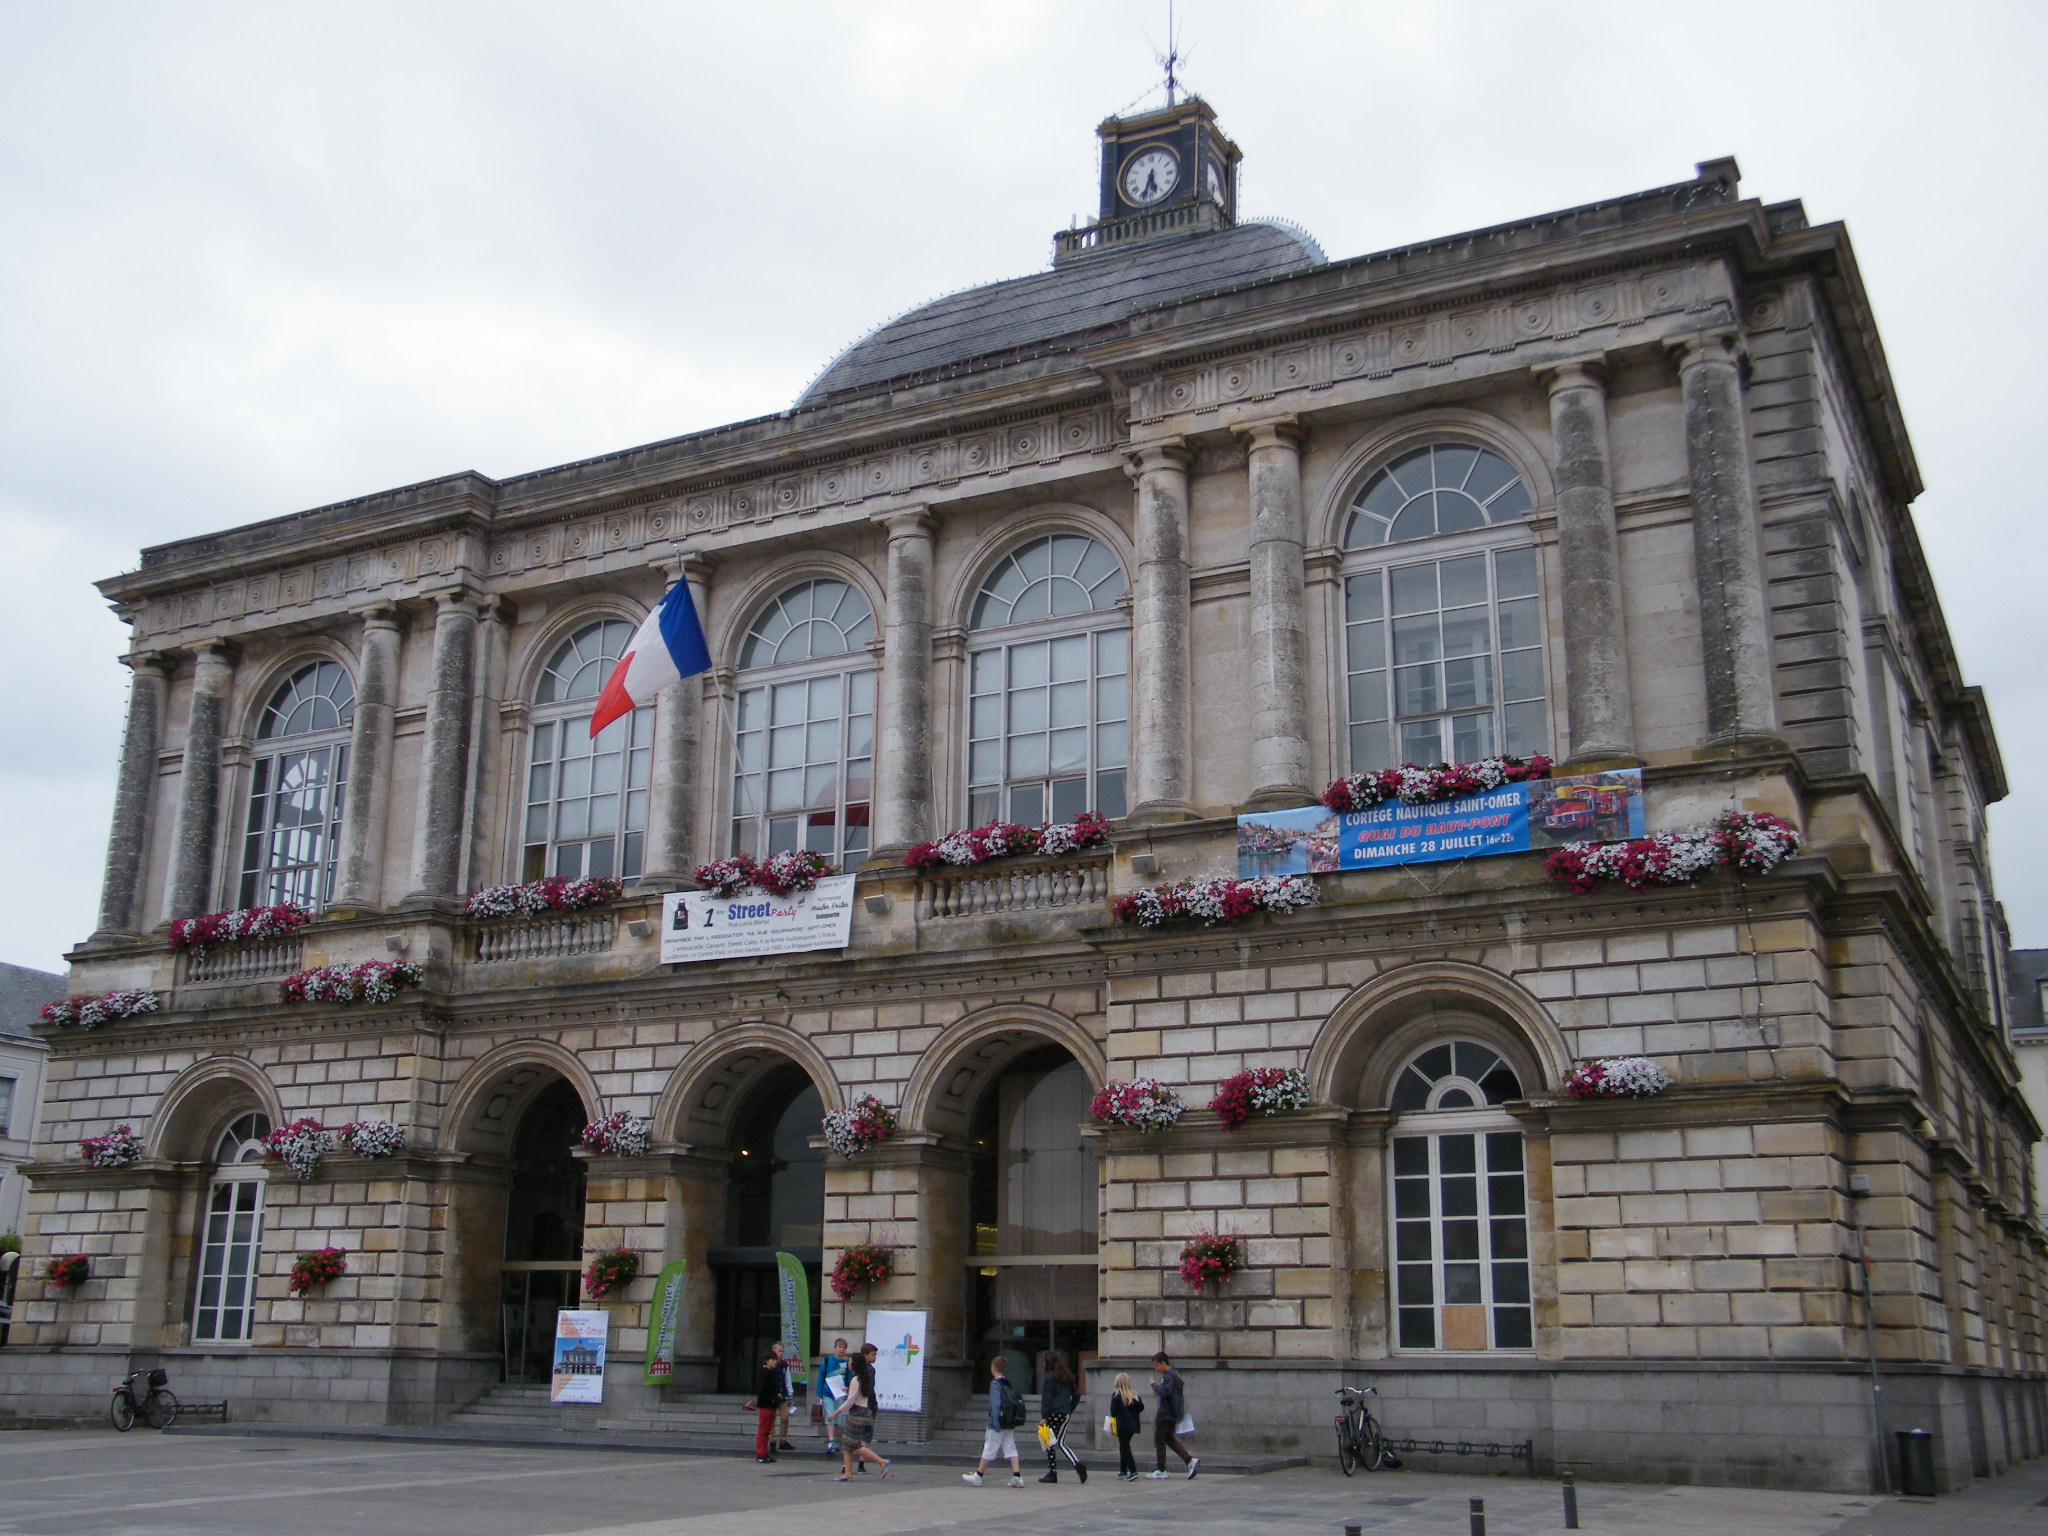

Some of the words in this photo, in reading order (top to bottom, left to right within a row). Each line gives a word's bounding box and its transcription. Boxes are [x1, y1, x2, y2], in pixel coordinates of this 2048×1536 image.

[1346, 806, 1392, 826] CORTÈGE
[1396, 801, 1450, 821] NAUTIQUE
[1454, 792, 1521, 814] SAINT-OMER
[1358, 827, 1396, 843] QUAI
[1400, 825, 1422, 838] DU
[1425, 814, 1510, 835] HAUT-PONT
[1354, 843, 1416, 859] DIMANCHE
[1420, 841, 1436, 852] 28
[1440, 835, 1483, 851] JUILLET
[700, 893, 741, 902] DIMAHE
[703, 908, 714, 927] 1
[728, 902, 771, 920] Street
[771, 905, 797, 922] Party
